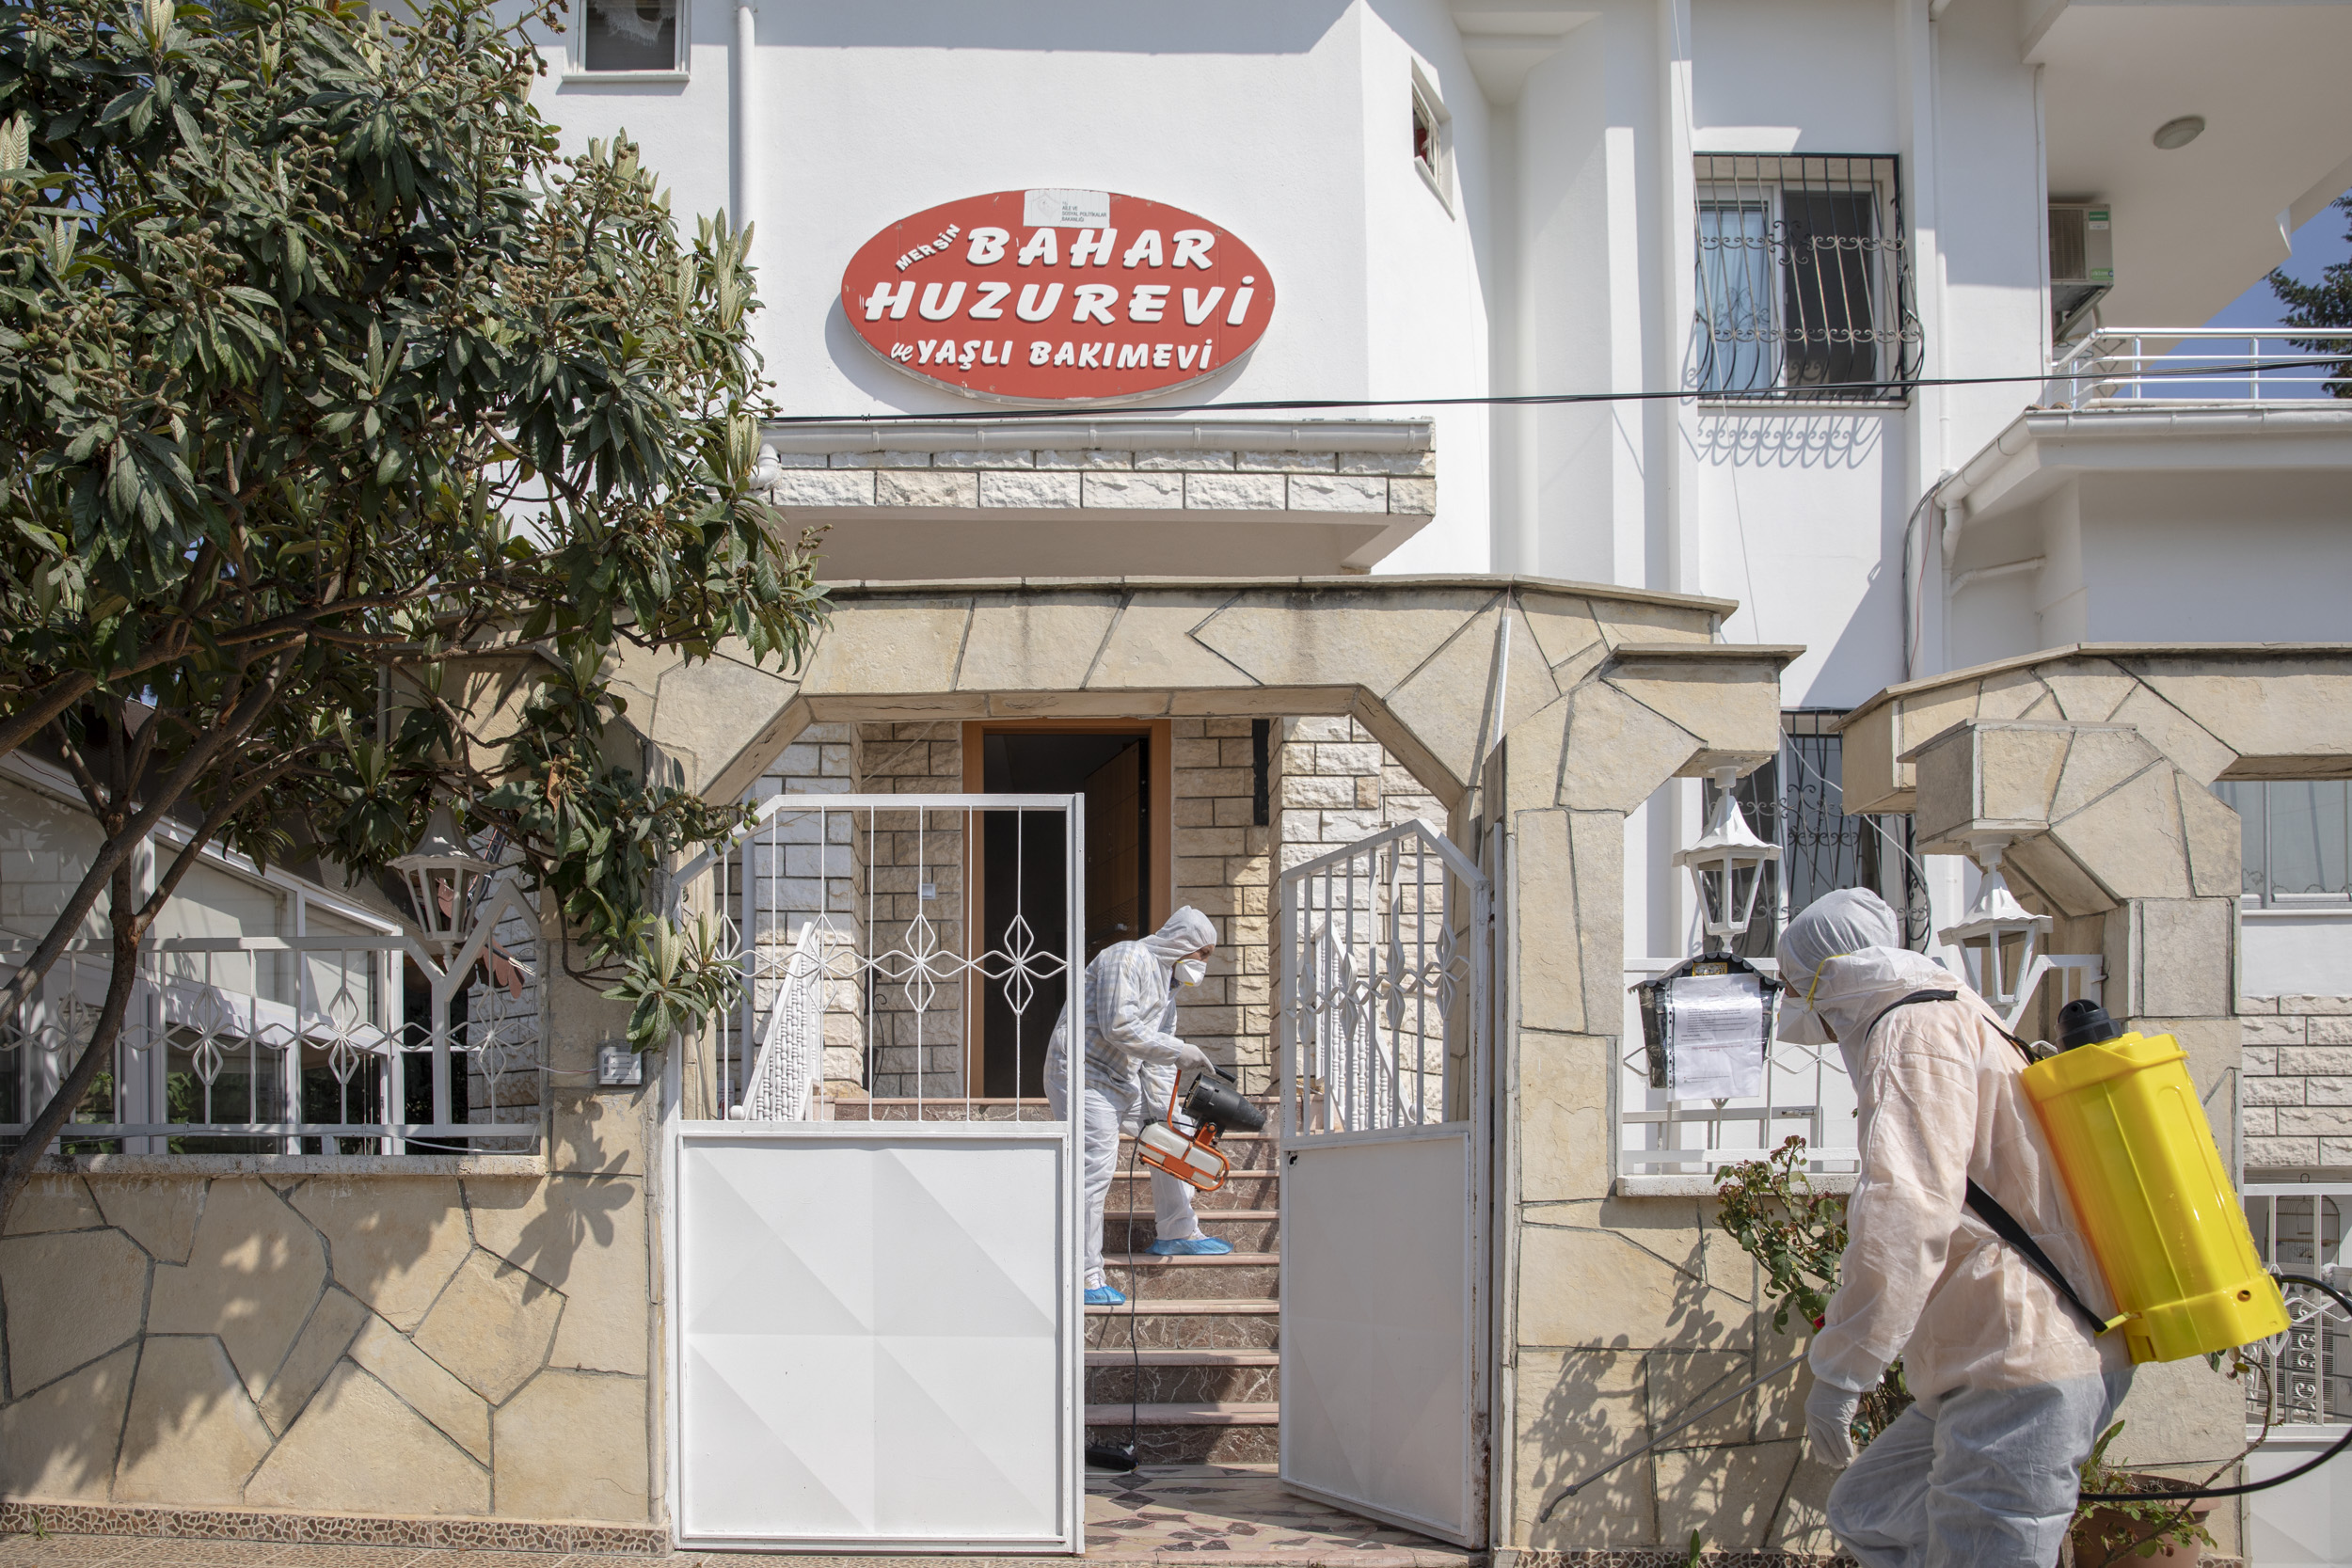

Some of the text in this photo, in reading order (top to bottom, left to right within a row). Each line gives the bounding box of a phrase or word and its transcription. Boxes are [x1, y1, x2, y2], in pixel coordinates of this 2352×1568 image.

[895, 223, 1216, 272] MERSİN BAHAR
[864, 276, 1256, 325] HUZUREVİ
[890, 339, 1214, 371] ve YAŞLI BAKIMEVİ
